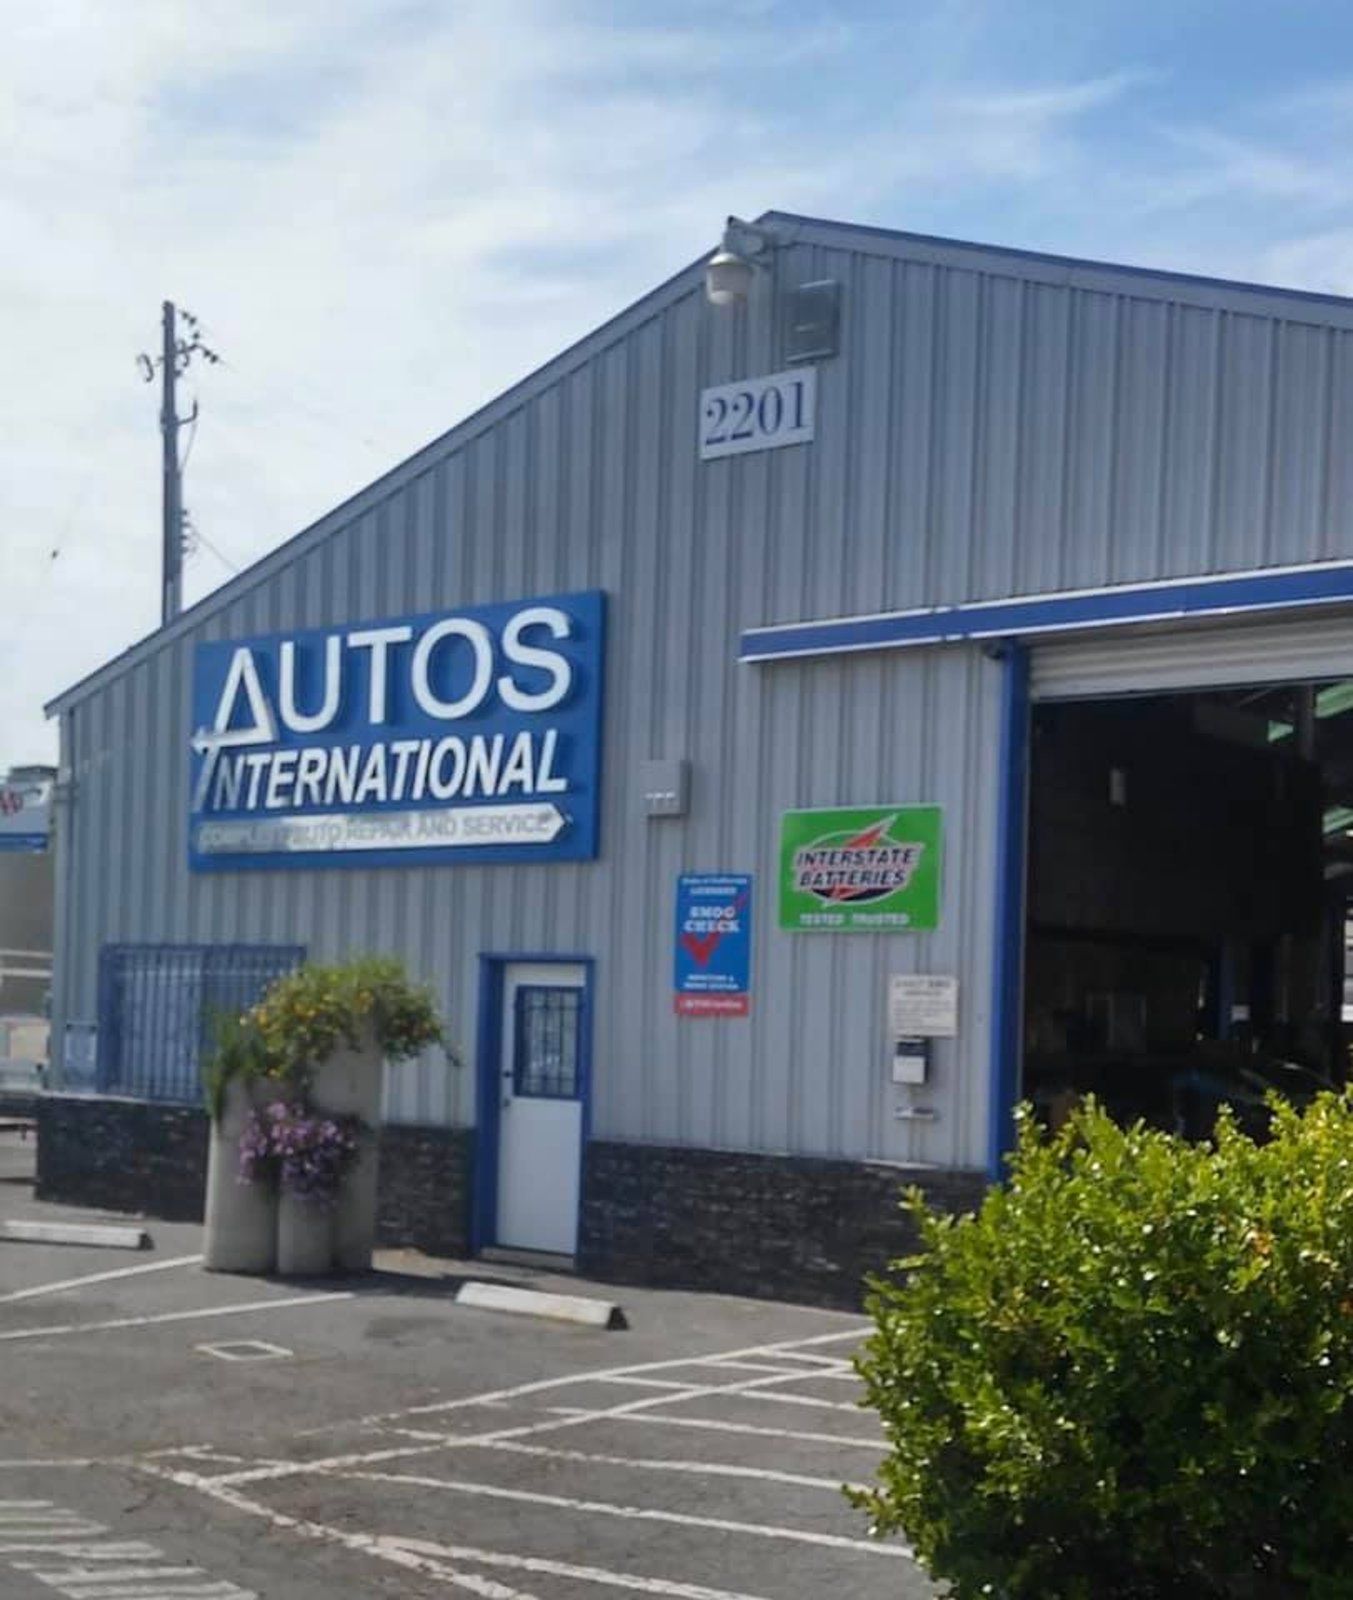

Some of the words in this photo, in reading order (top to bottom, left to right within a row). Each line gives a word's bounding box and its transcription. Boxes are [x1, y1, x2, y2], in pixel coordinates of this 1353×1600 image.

[705, 381, 808, 446] 2201
[208, 606, 572, 743] AUTOS
[195, 729, 568, 811] INTERNATIONAL
[418, 811, 456, 838] AND
[463, 813, 552, 836] SERVICE
[797, 848, 915, 866] INTERSTATE
[800, 868, 907, 887] BATTERIES
[683, 919, 740, 933] CHECK
